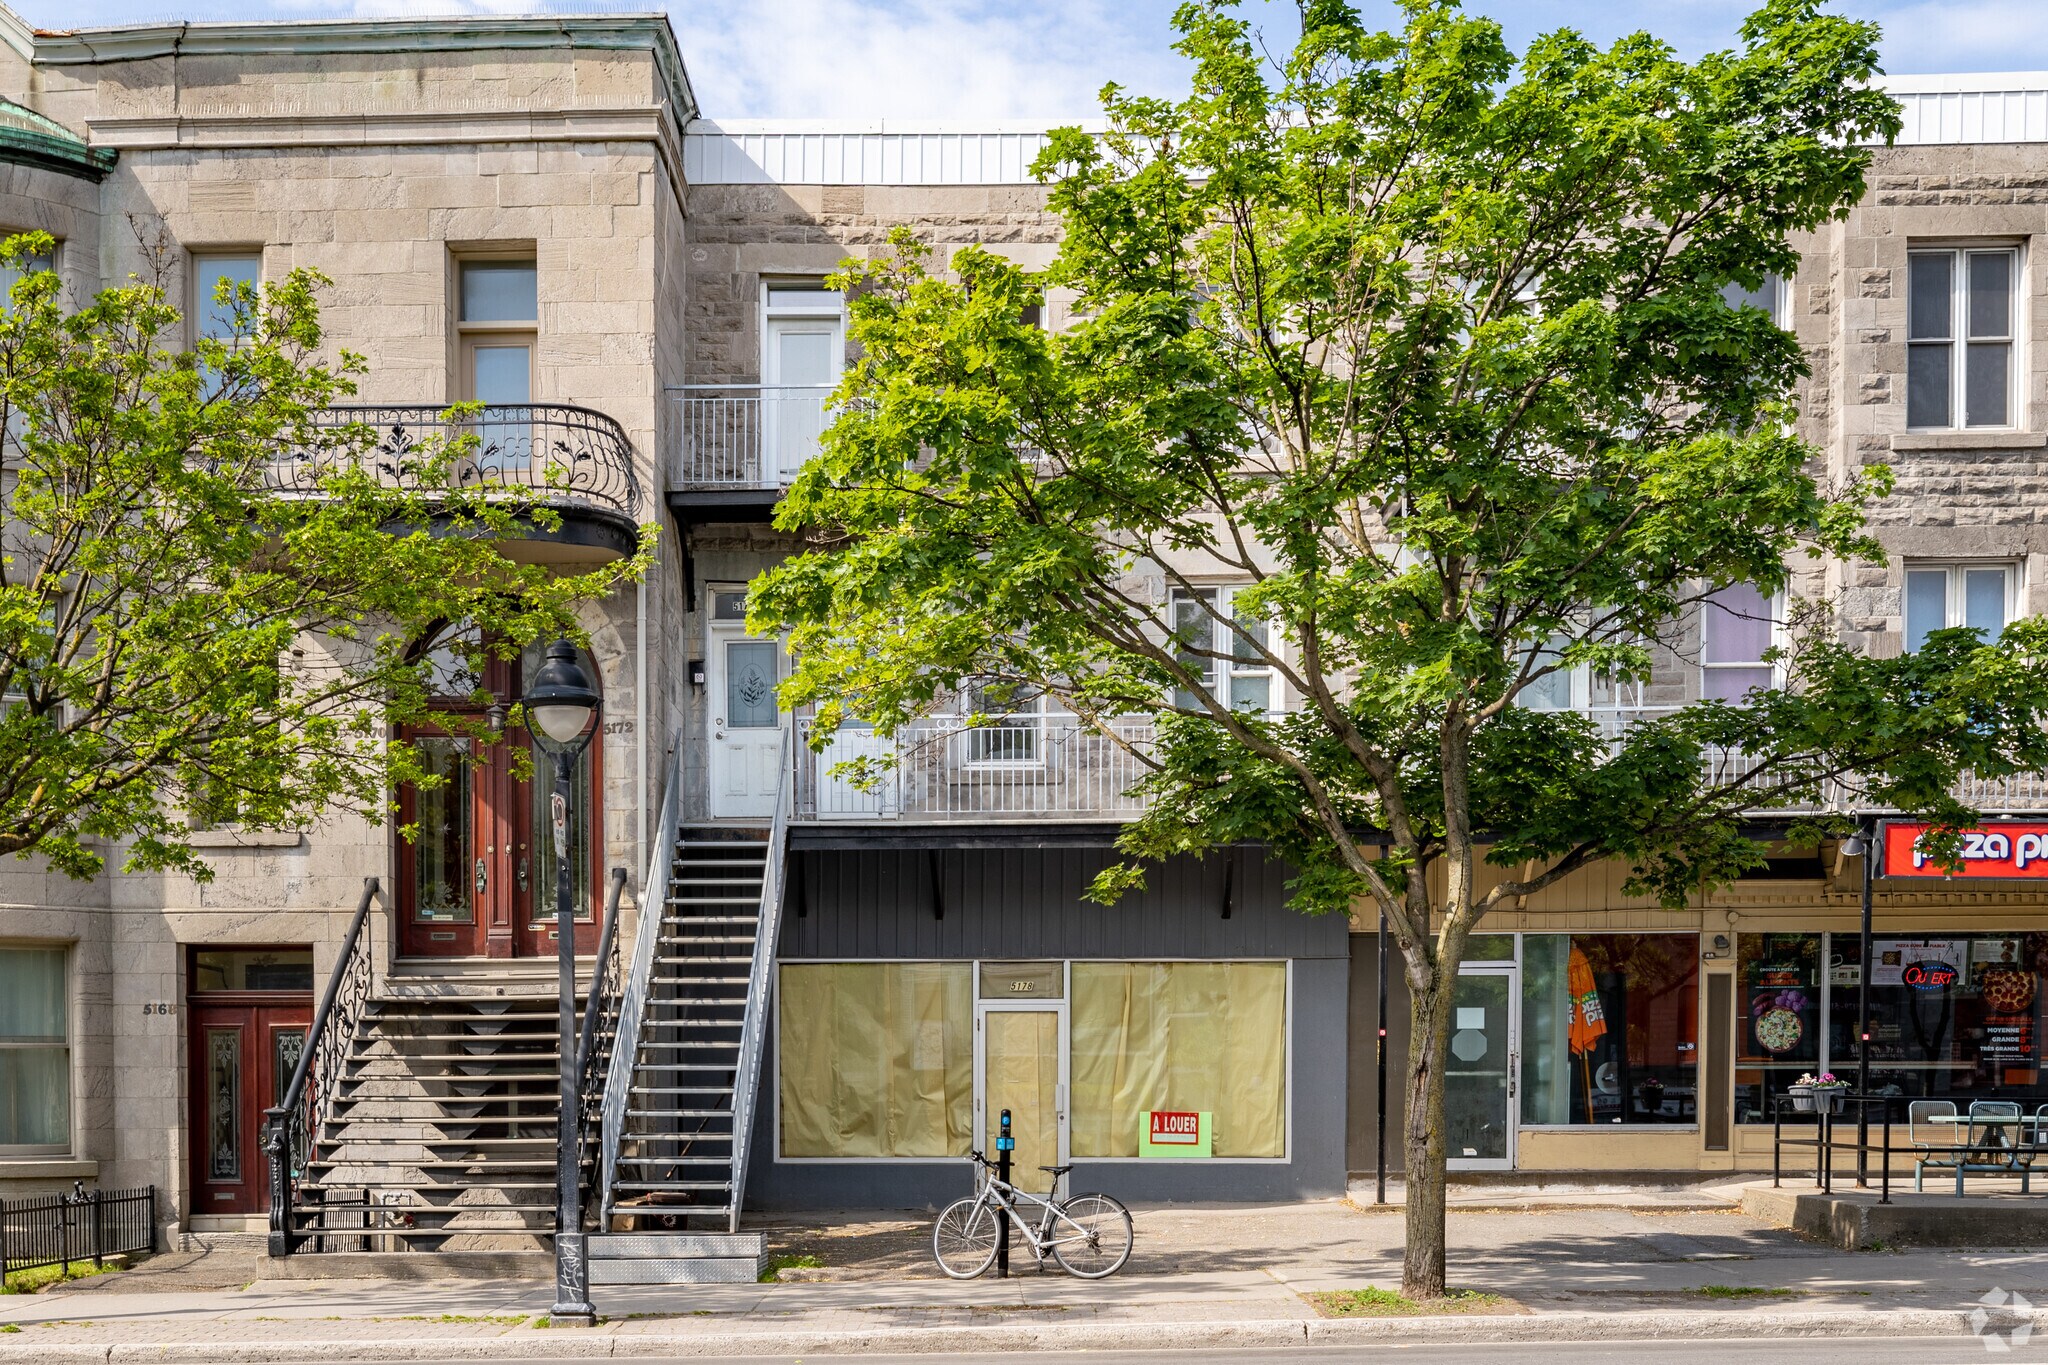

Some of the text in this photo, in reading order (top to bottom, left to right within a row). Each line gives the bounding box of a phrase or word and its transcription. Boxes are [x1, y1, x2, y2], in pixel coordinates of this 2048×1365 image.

[604, 721, 634, 735] 5172
[1011, 982, 1032, 991] 5178
[143, 1003, 177, 1015] 5168
[1153, 1115, 1197, 1132] A LOUER
